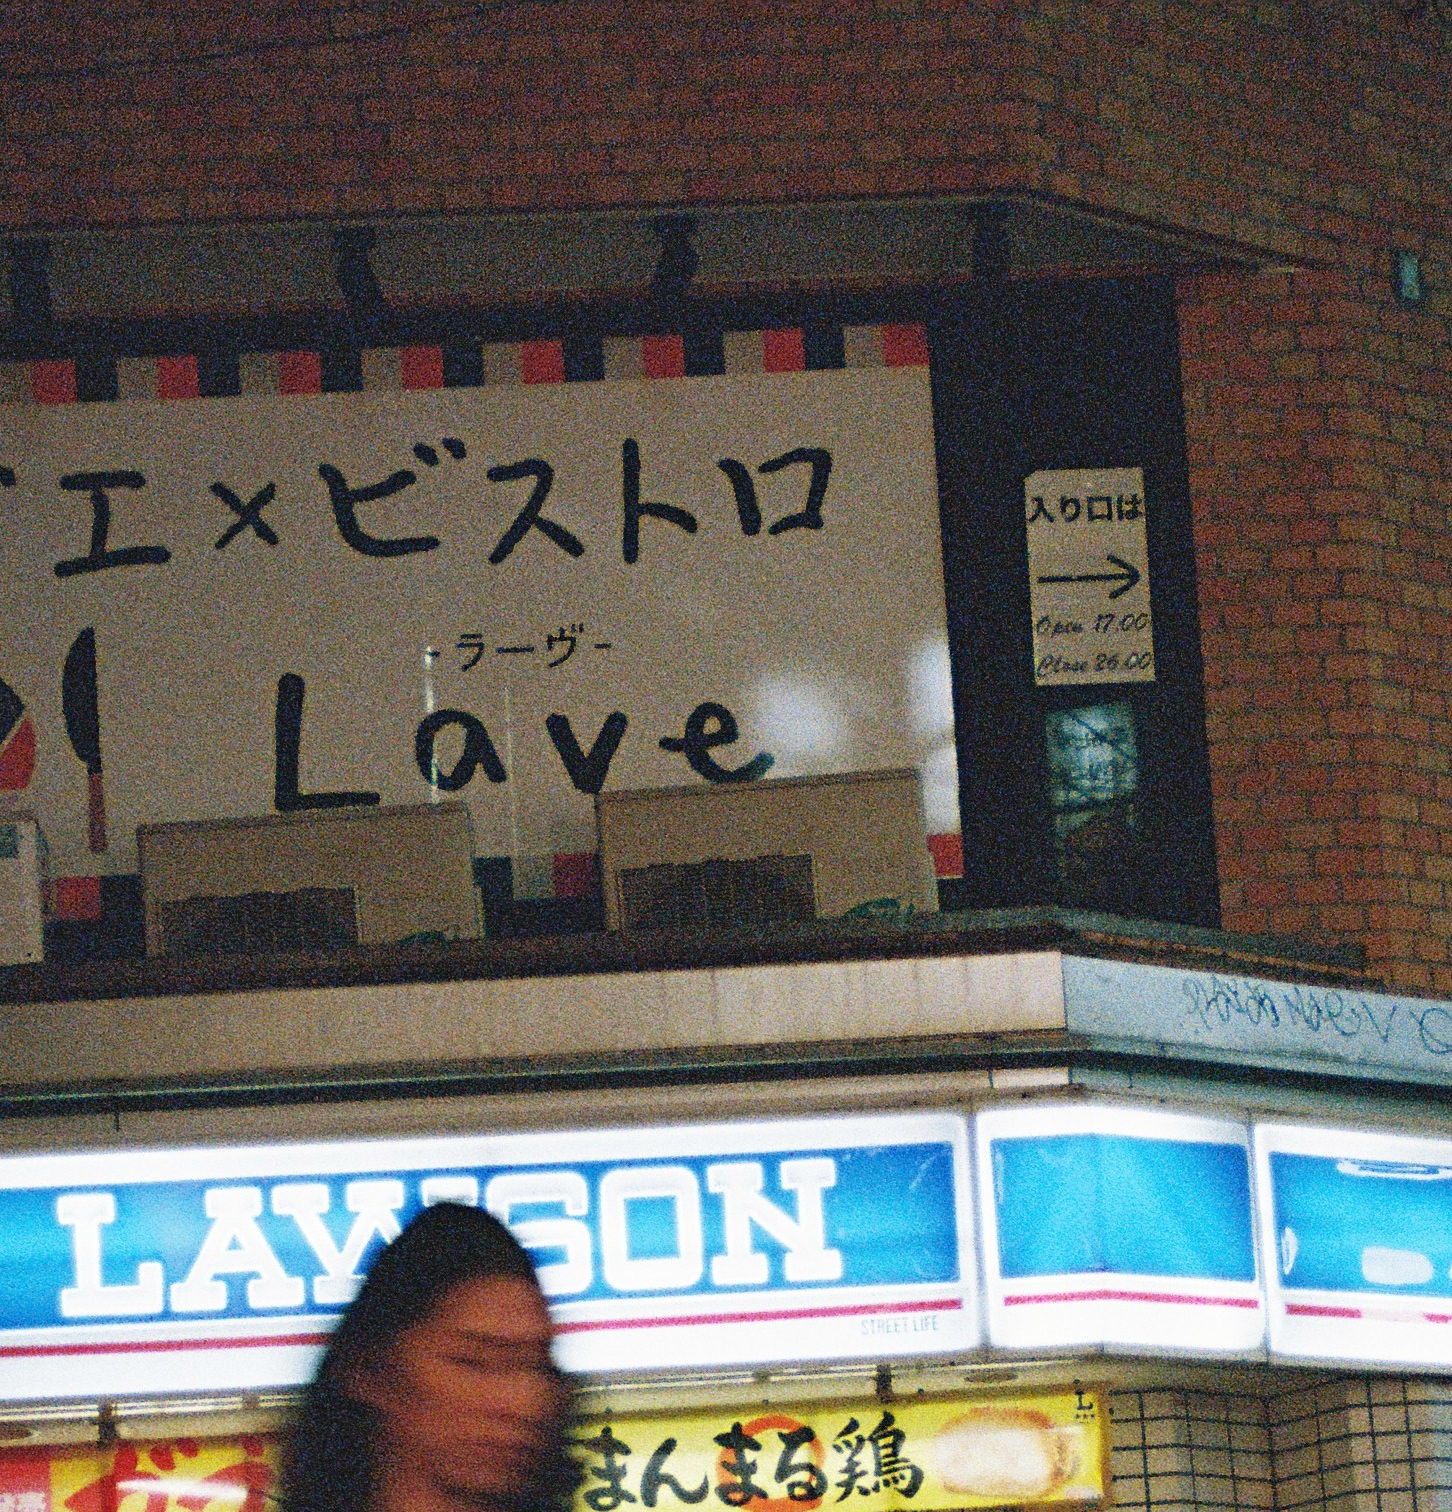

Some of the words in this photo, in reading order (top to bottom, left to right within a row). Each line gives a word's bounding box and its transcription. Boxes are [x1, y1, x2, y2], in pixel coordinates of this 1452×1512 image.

[1028, 494, 1145, 525] 入り口は
[274, 673, 774, 812] Lave
[575, 1412, 925, 1512] まんまる鶏
